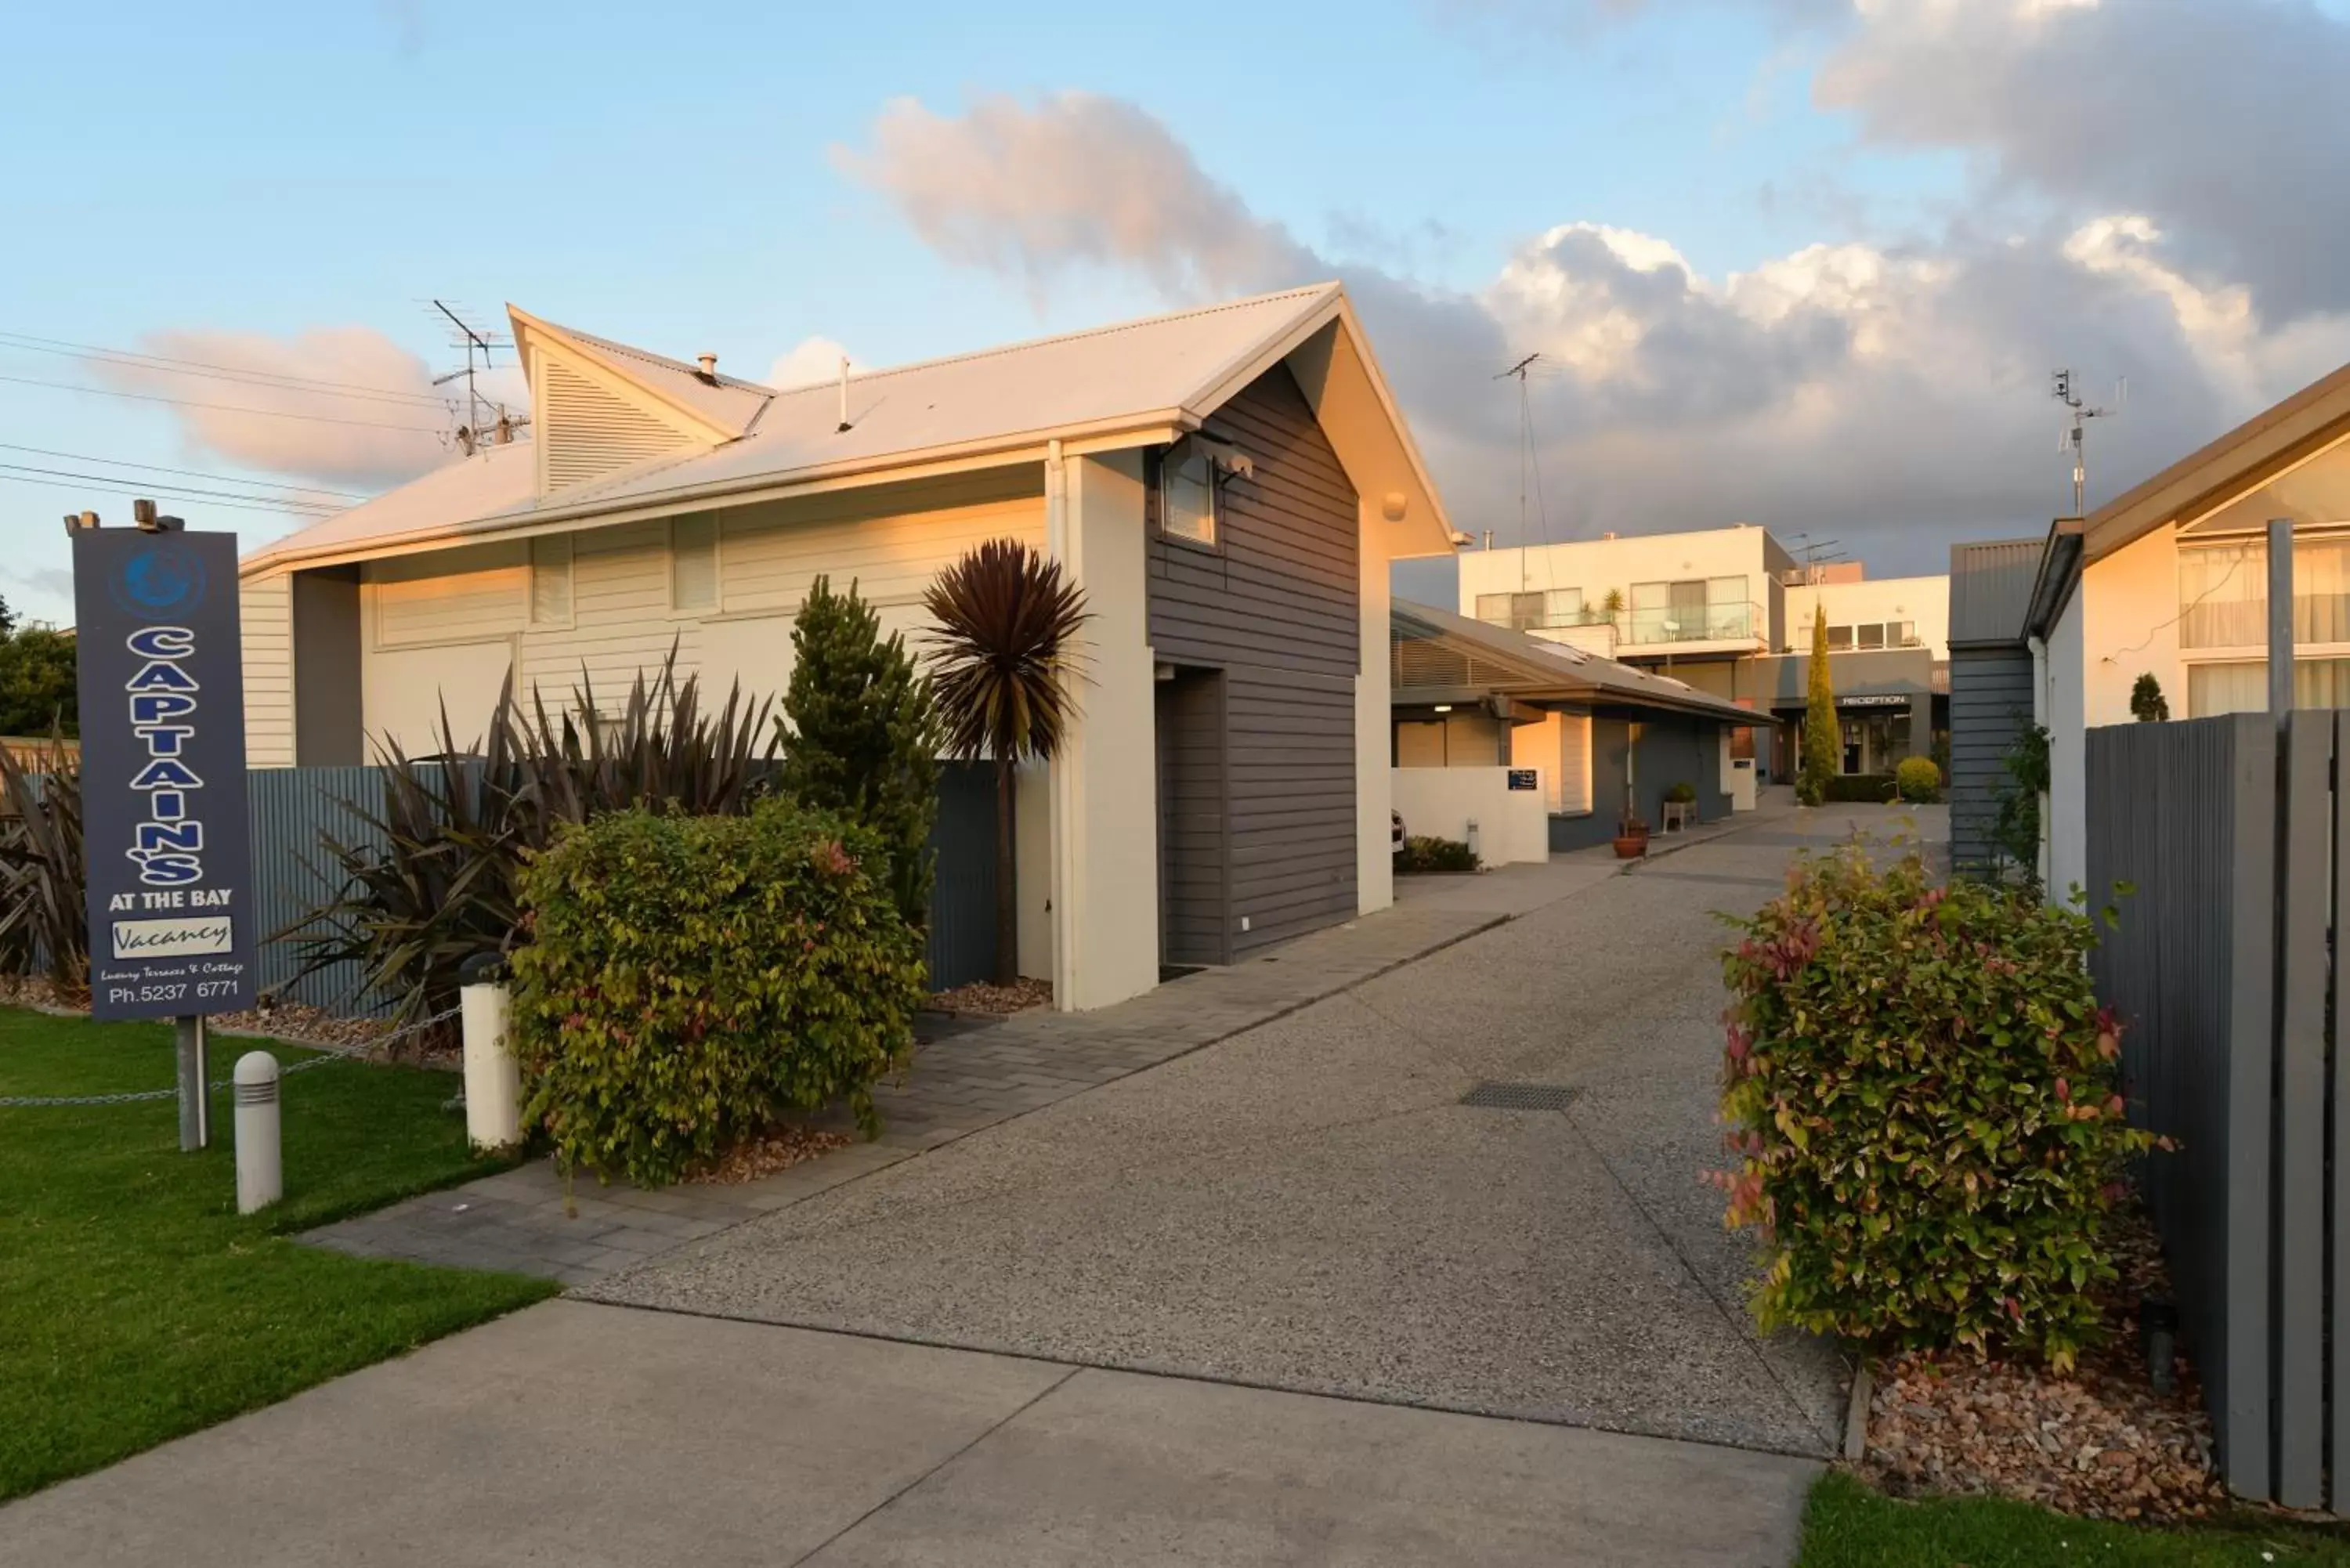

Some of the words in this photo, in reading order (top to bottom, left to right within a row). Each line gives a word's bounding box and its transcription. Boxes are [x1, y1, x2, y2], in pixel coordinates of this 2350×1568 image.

[1842, 695, 1905, 705] RECEPTION
[125, 626, 204, 885] CAPTAIN'S
[109, 894, 136, 912] AT
[141, 891, 184, 909] THE
[190, 889, 232, 906] BAY
[114, 927, 227, 950] Vacancy
[197, 981, 238, 997] 6771
